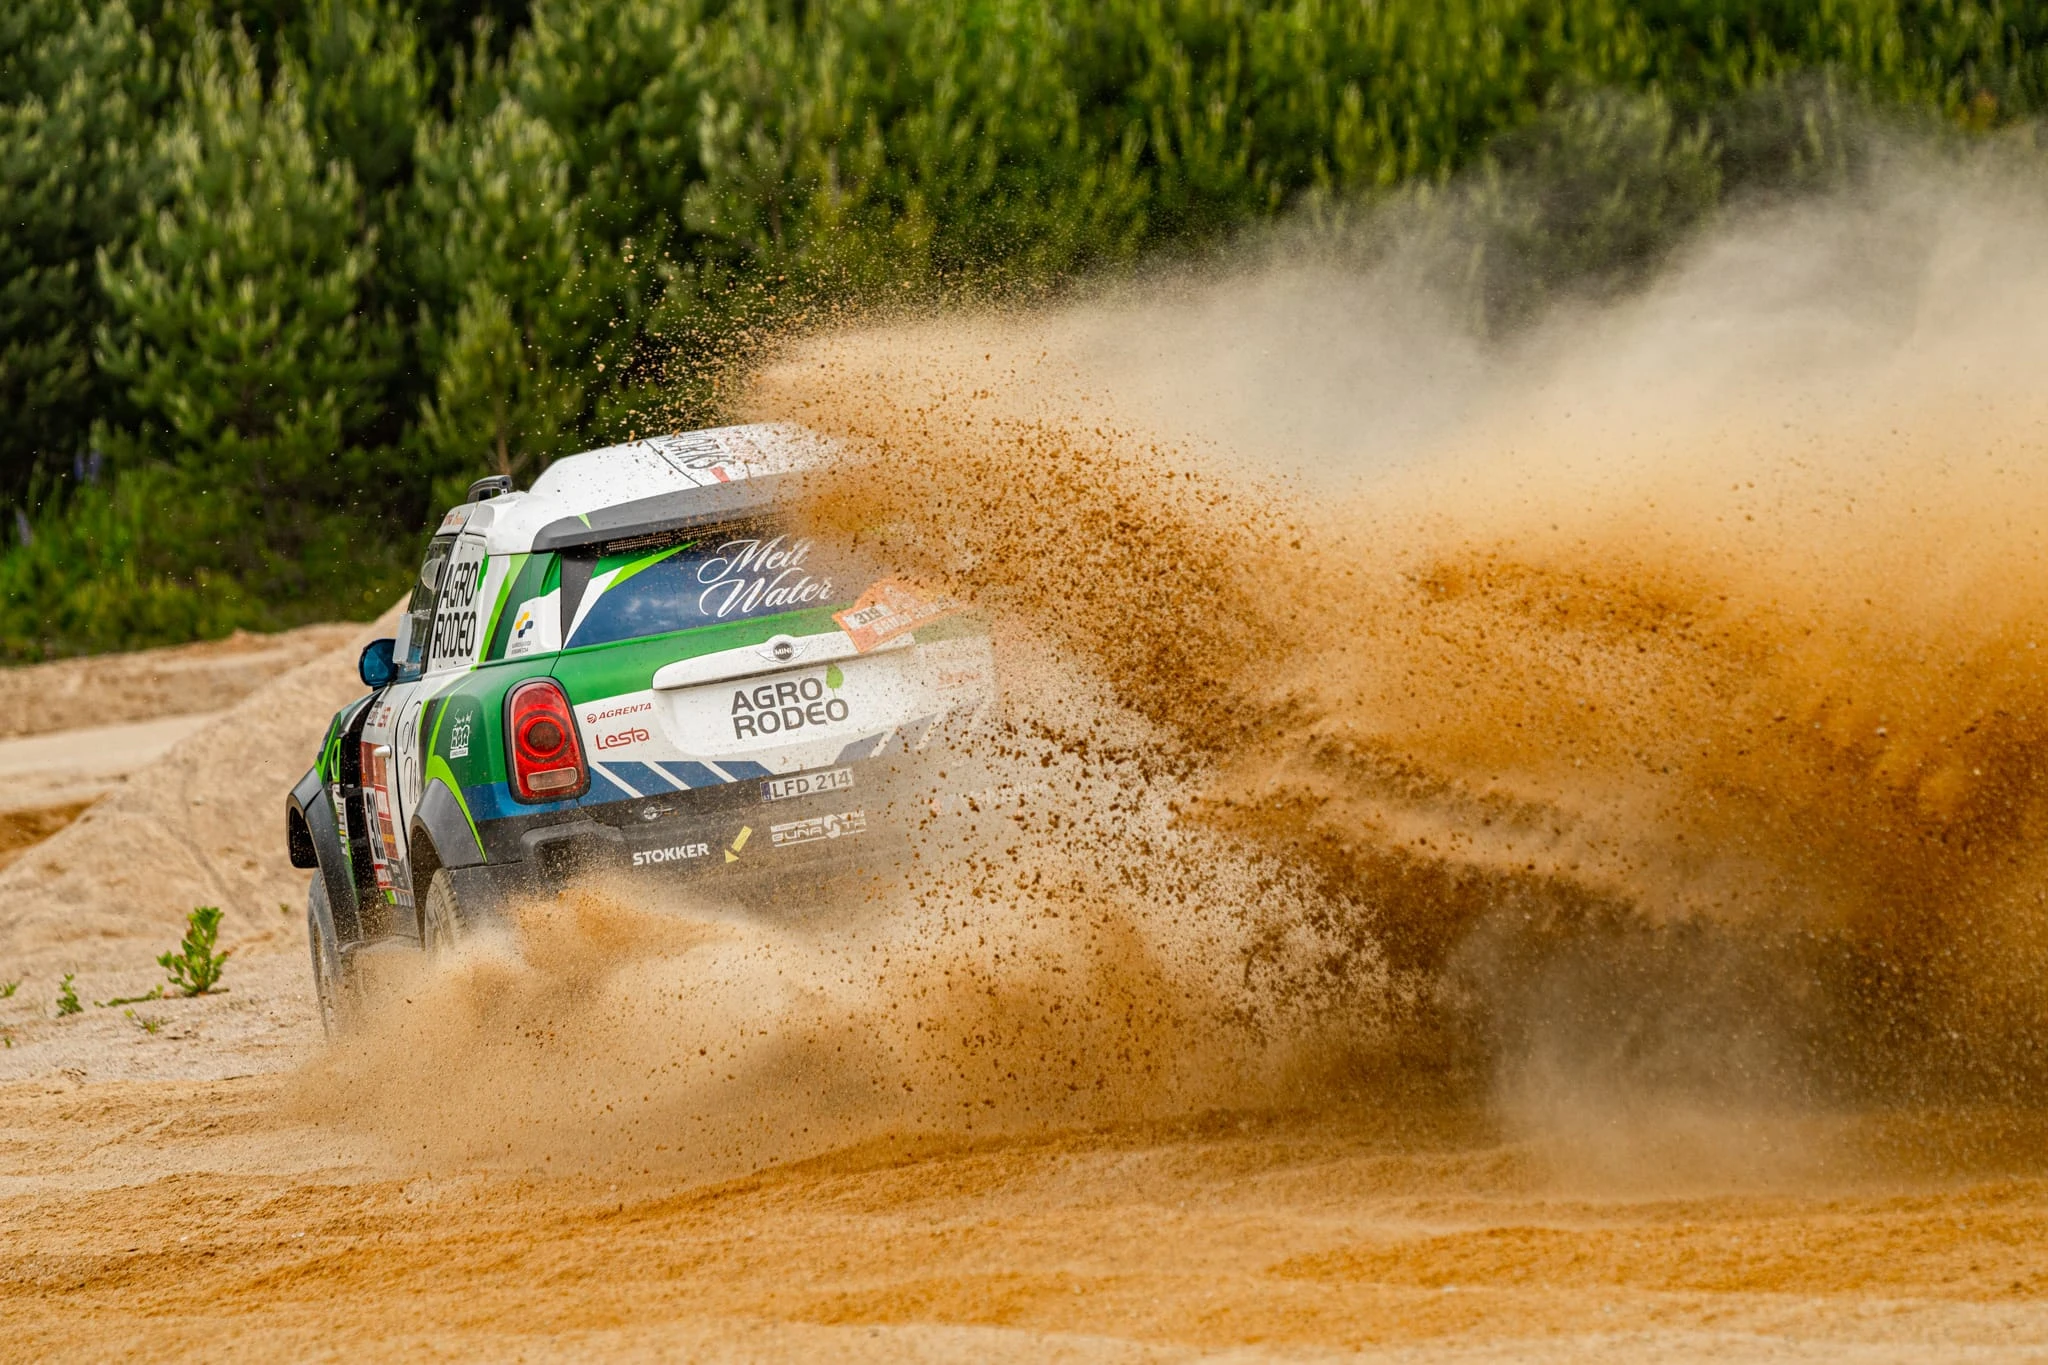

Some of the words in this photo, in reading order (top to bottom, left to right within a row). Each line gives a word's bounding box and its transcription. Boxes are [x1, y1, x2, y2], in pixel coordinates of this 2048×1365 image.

[697, 533, 815, 584] Melt
[439, 561, 478, 609] AGRO
[699, 567, 835, 618] Water
[853, 606, 885, 625] 319
[432, 611, 477, 659] RODEO
[598, 702, 652, 720] AGRENTA
[731, 677, 823, 715] AGRO
[595, 726, 650, 750] Lesta
[732, 698, 850, 740] RODEO
[772, 778, 810, 798] LFD
[815, 770, 851, 791] 214
[632, 842, 710, 866] STOKKER
